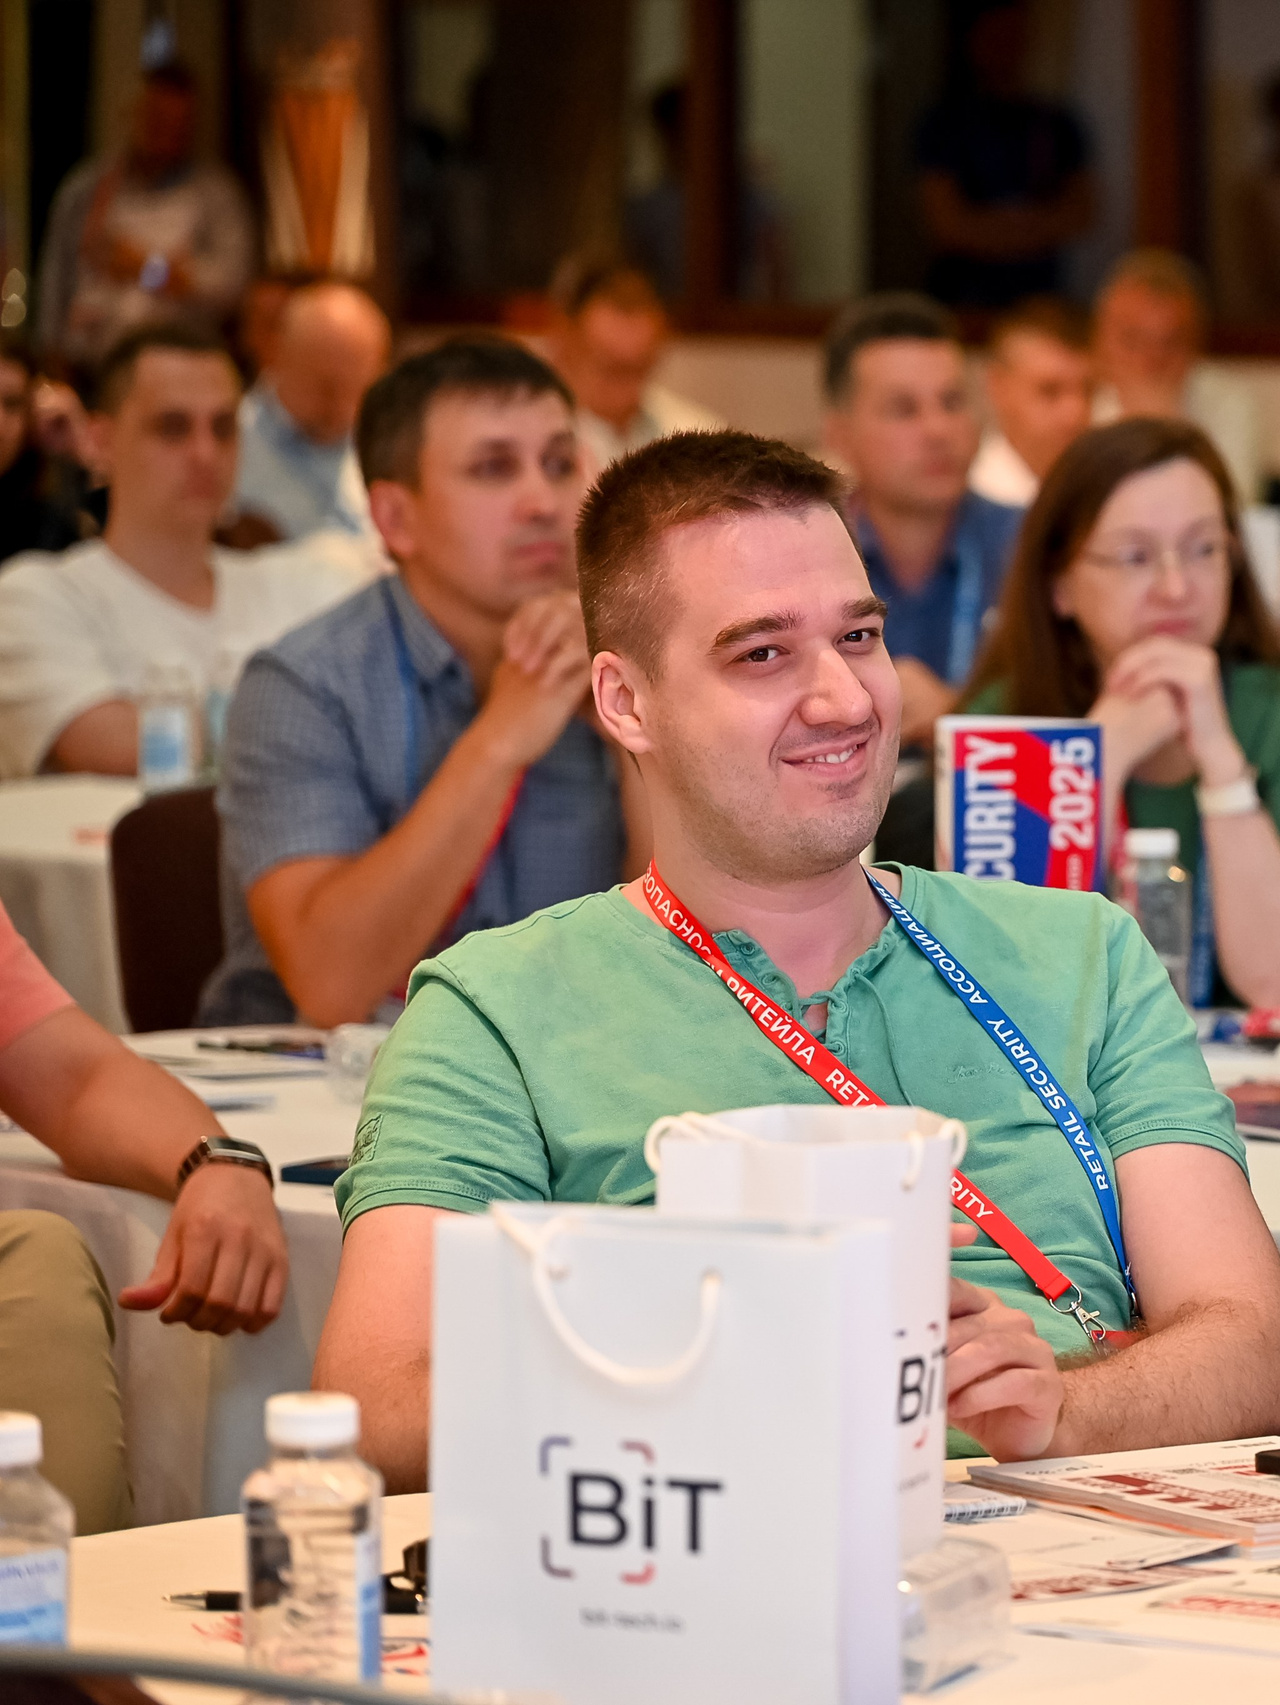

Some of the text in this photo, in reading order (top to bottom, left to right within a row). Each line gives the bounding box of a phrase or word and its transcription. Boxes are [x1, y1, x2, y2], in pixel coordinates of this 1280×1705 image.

[963, 735, 1017, 880] CURITY
[1049, 737, 1095, 850] 2025
[876, 886, 989, 1003] АССОЦИАЦИЯ
[727, 976, 816, 1065] РИТЕЙЛА
[825, 1068, 993, 1218] RET RITY
[988, 1018, 1109, 1191] RETAIL SECURITY
[568, 1470, 724, 1556] BiT
